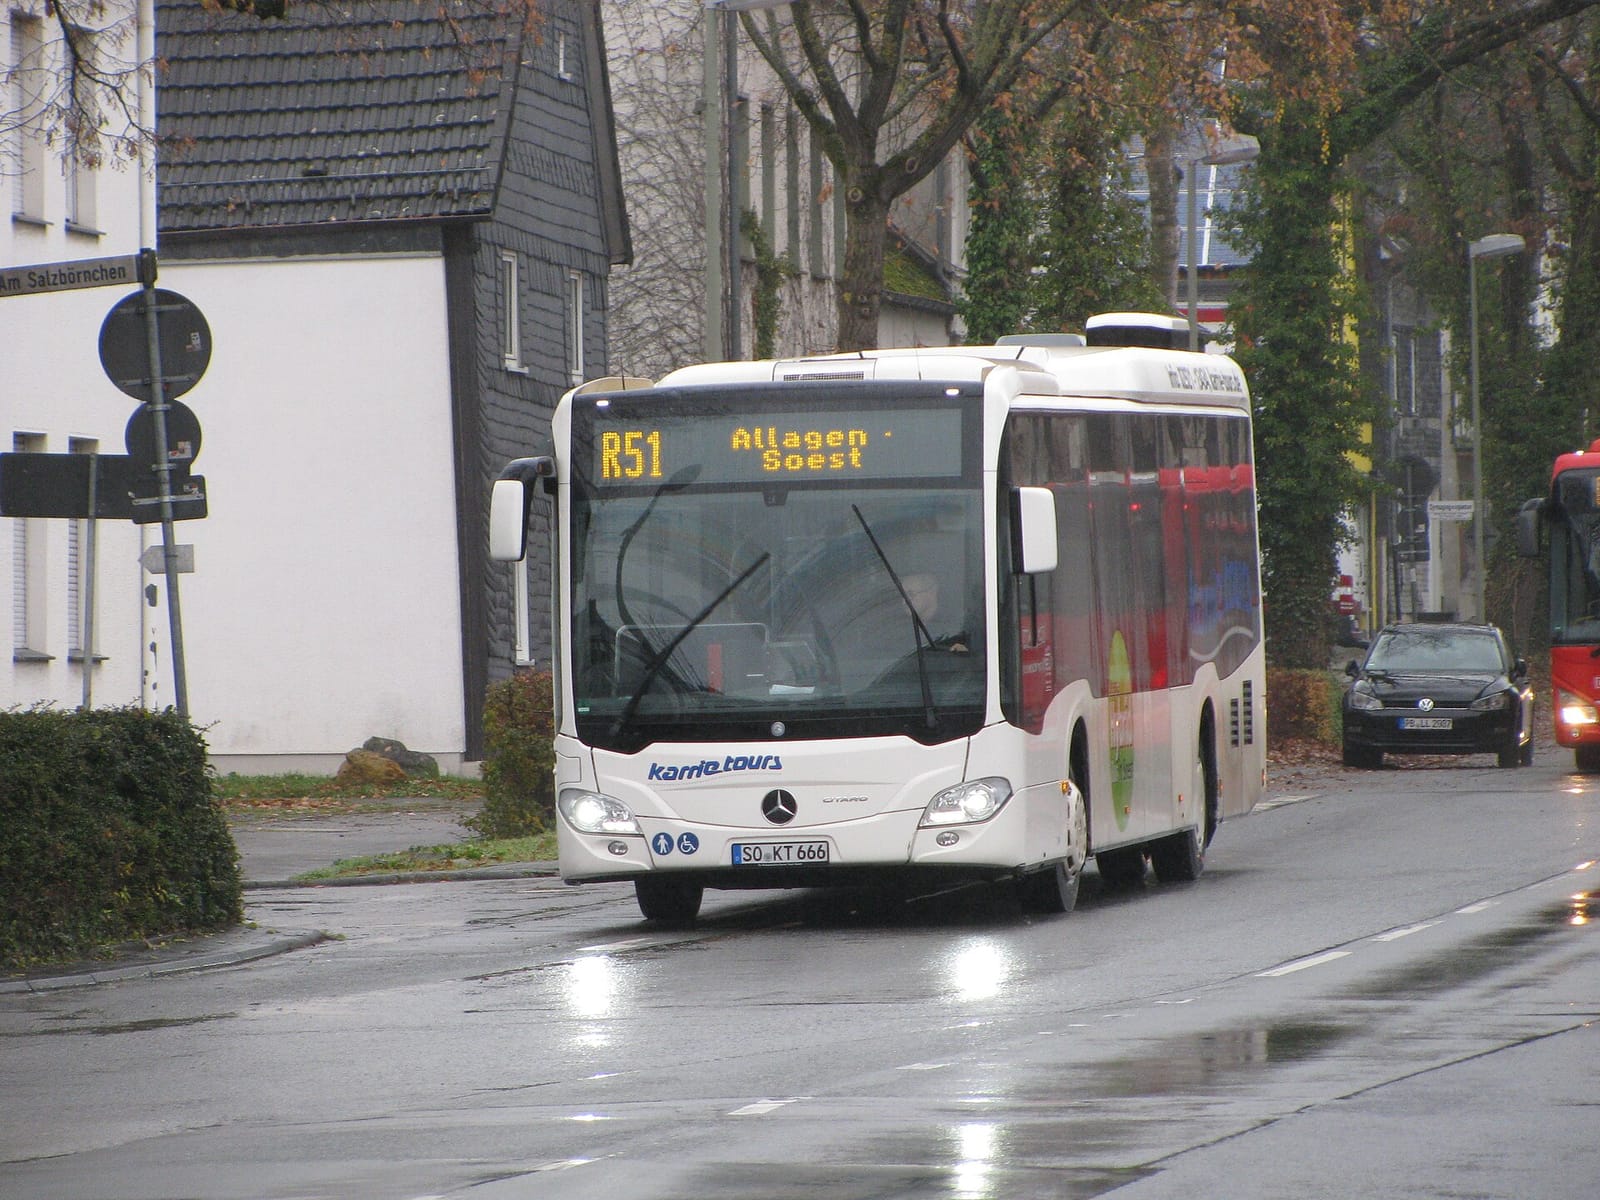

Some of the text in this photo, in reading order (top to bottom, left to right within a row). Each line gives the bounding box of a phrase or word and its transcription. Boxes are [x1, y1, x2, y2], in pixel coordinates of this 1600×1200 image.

[0, 264, 126, 291] Am Salzbörnchen
[731, 427, 868, 449] Allagen
[602, 431, 662, 478] R51
[763, 447, 862, 471] Soest
[723, 755, 783, 772] tours
[822, 796, 869, 804] CITARO
[742, 846, 763, 862] SO
[773, 845, 793, 861] KT
[797, 844, 826, 860] 666
